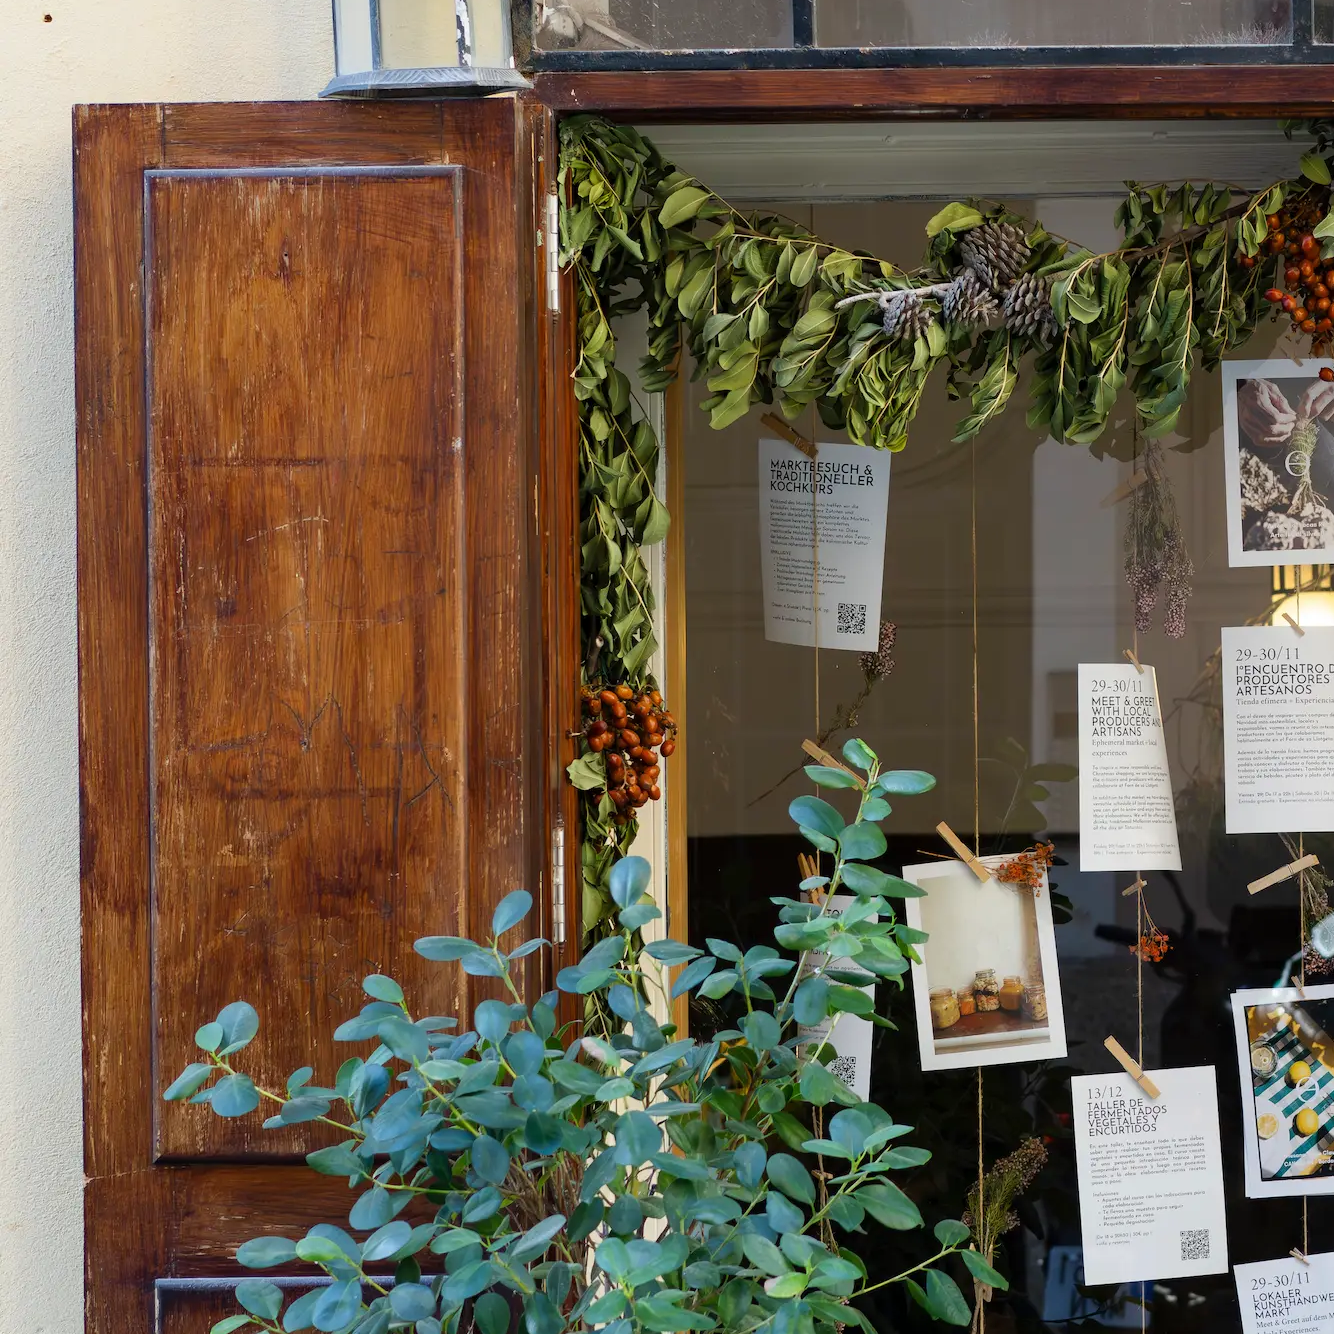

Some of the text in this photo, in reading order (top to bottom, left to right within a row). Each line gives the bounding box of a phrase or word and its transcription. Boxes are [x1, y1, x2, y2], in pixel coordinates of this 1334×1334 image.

[864, 465, 872, 475] &
[771, 470, 874, 486] TRADITIONELLER
[1236, 646, 1300, 661] 29-30/11
[1092, 678, 1142, 692] 29-30/11
[1236, 674, 1330, 685] PRODUCTORES
[1236, 685, 1312, 696] ARTESANOS
[1092, 696, 1154, 706] MEET & GREET
[1092, 707, 1151, 716] WITH LOCAL
[1092, 717, 1150, 726] PRODUCERS
[1092, 727, 1141, 736] ARTISANS
[1092, 739, 1124, 747] Ephemeral
[1088, 1085, 1122, 1099] 13/12
[1087, 1098, 1143, 1111] TALLER DE
[1088, 1105, 1167, 1119] FERMENTADOS
[1088, 1114, 1159, 1128] VEGETALES Y
[1089, 1123, 1157, 1137] ENCURTIDOS
[1251, 1271, 1310, 1290] 29-30/11
[1253, 1289, 1301, 1302] LOKALER
[1255, 1308, 1291, 1319] MARKT
[1256, 1320, 1273, 1328] Meet
